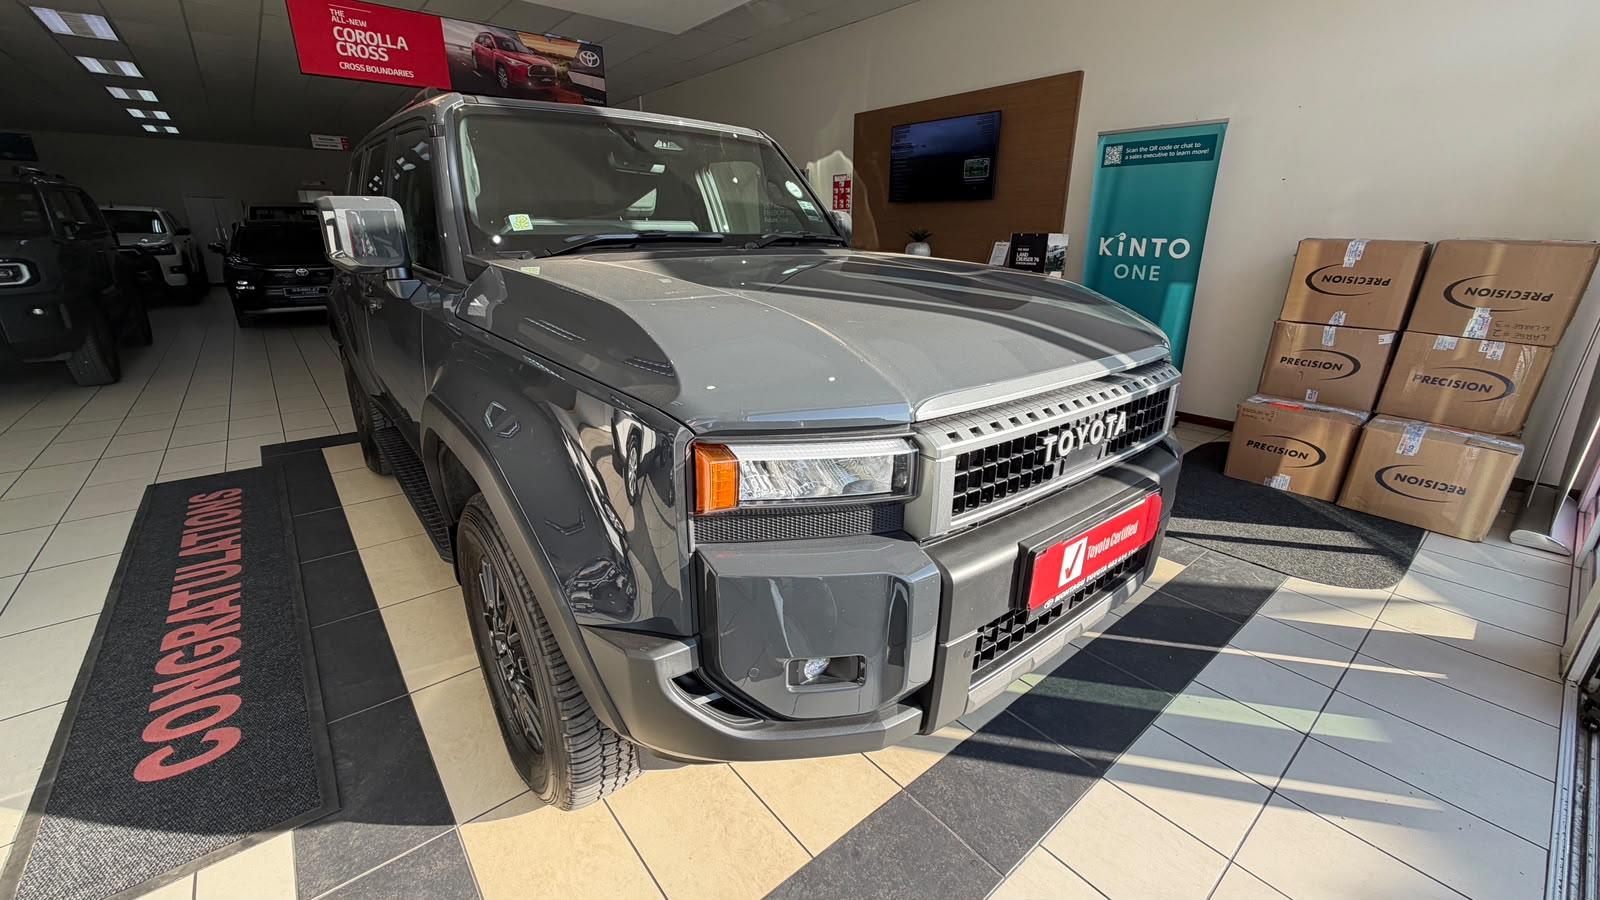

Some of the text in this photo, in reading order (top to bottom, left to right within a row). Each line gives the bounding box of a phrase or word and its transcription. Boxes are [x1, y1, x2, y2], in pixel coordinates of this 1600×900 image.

[329, 8, 345, 17] THE
[331, 16, 367, 27] ALL-NEW
[333, 26, 409, 51] COROLLA
[336, 41, 389, 62] CROSS
[339, 61, 414, 78] CROSS BOUNDARIES
[1114, 263, 1160, 281] ONE
[1321, 275, 1391, 286] PRECISION
[1464, 287, 1554, 302] PRECISION
[1280, 356, 1343, 372] PRECISION
[1413, 373, 1493, 394] PRECISION
[1043, 411, 1126, 462] TOYOTA
[1246, 439, 1309, 460] PRECISION
[1087, 537, 1110, 560] Toyota
[1110, 520, 1139, 546] Certified
[133, 488, 242, 782] CONGRATULATIONS
